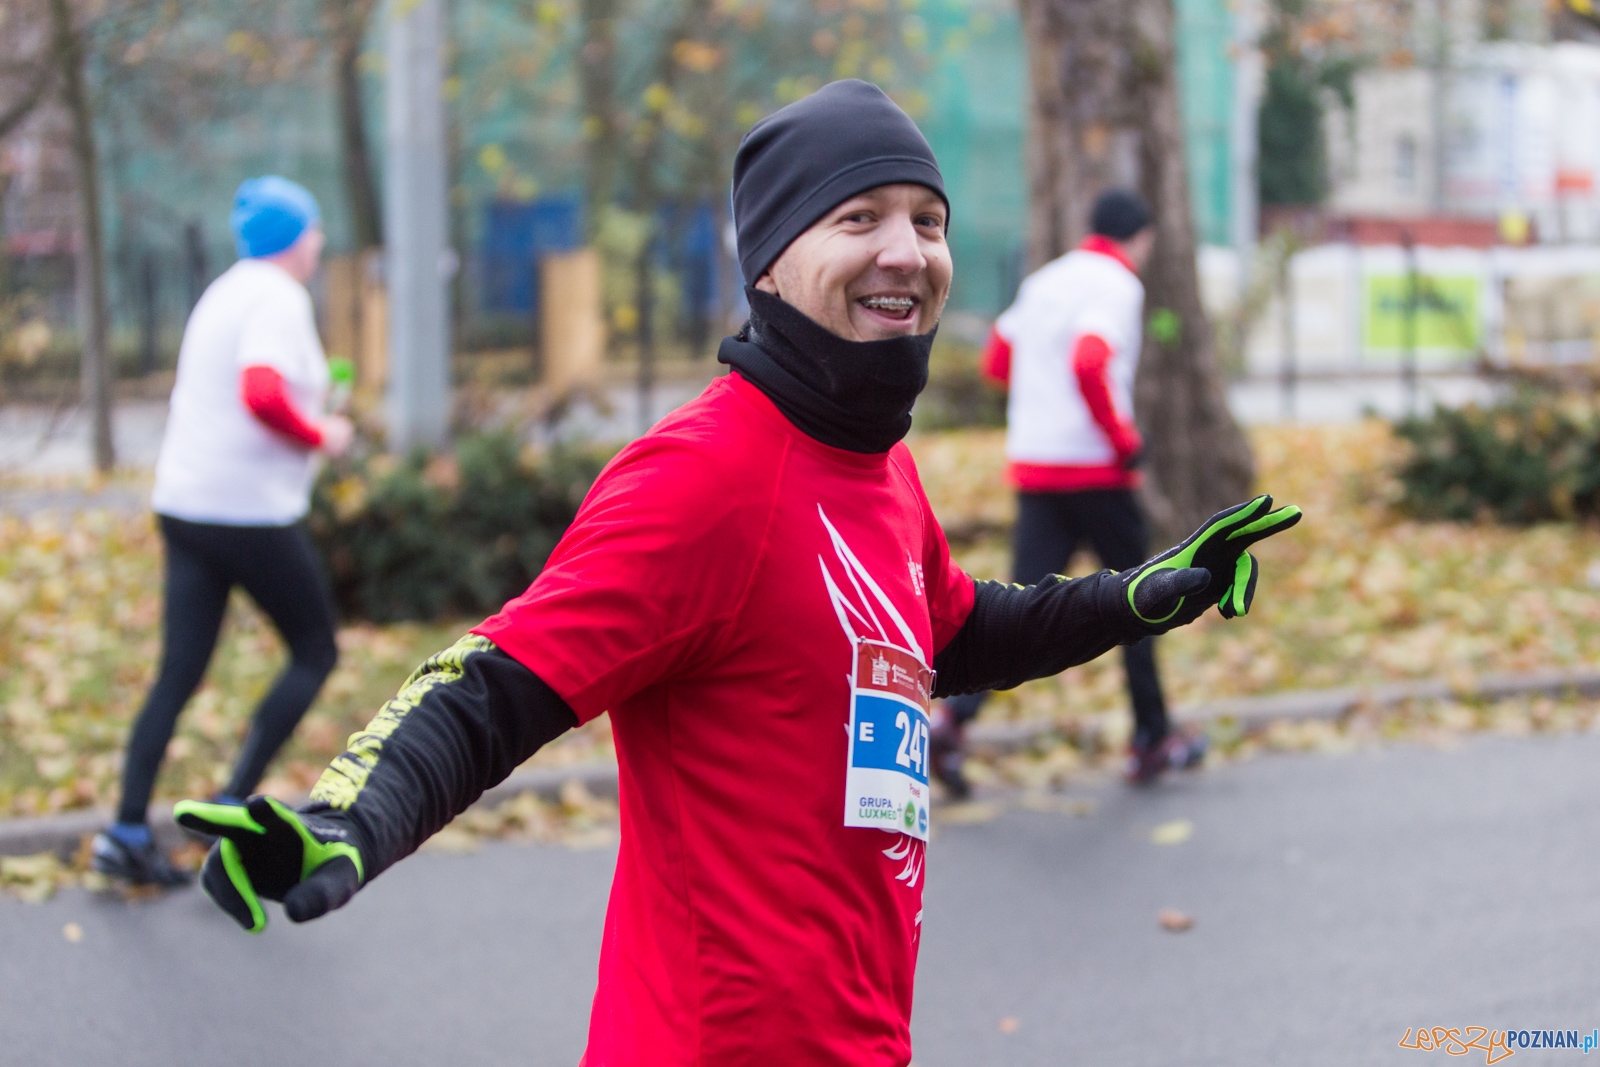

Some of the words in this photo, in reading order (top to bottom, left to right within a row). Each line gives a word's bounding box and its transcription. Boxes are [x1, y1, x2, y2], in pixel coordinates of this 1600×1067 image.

[859, 722, 875, 742] E
[895, 711, 928, 777] 247
[859, 797, 893, 808] GRUPA
[859, 808, 897, 820] LUXMED
